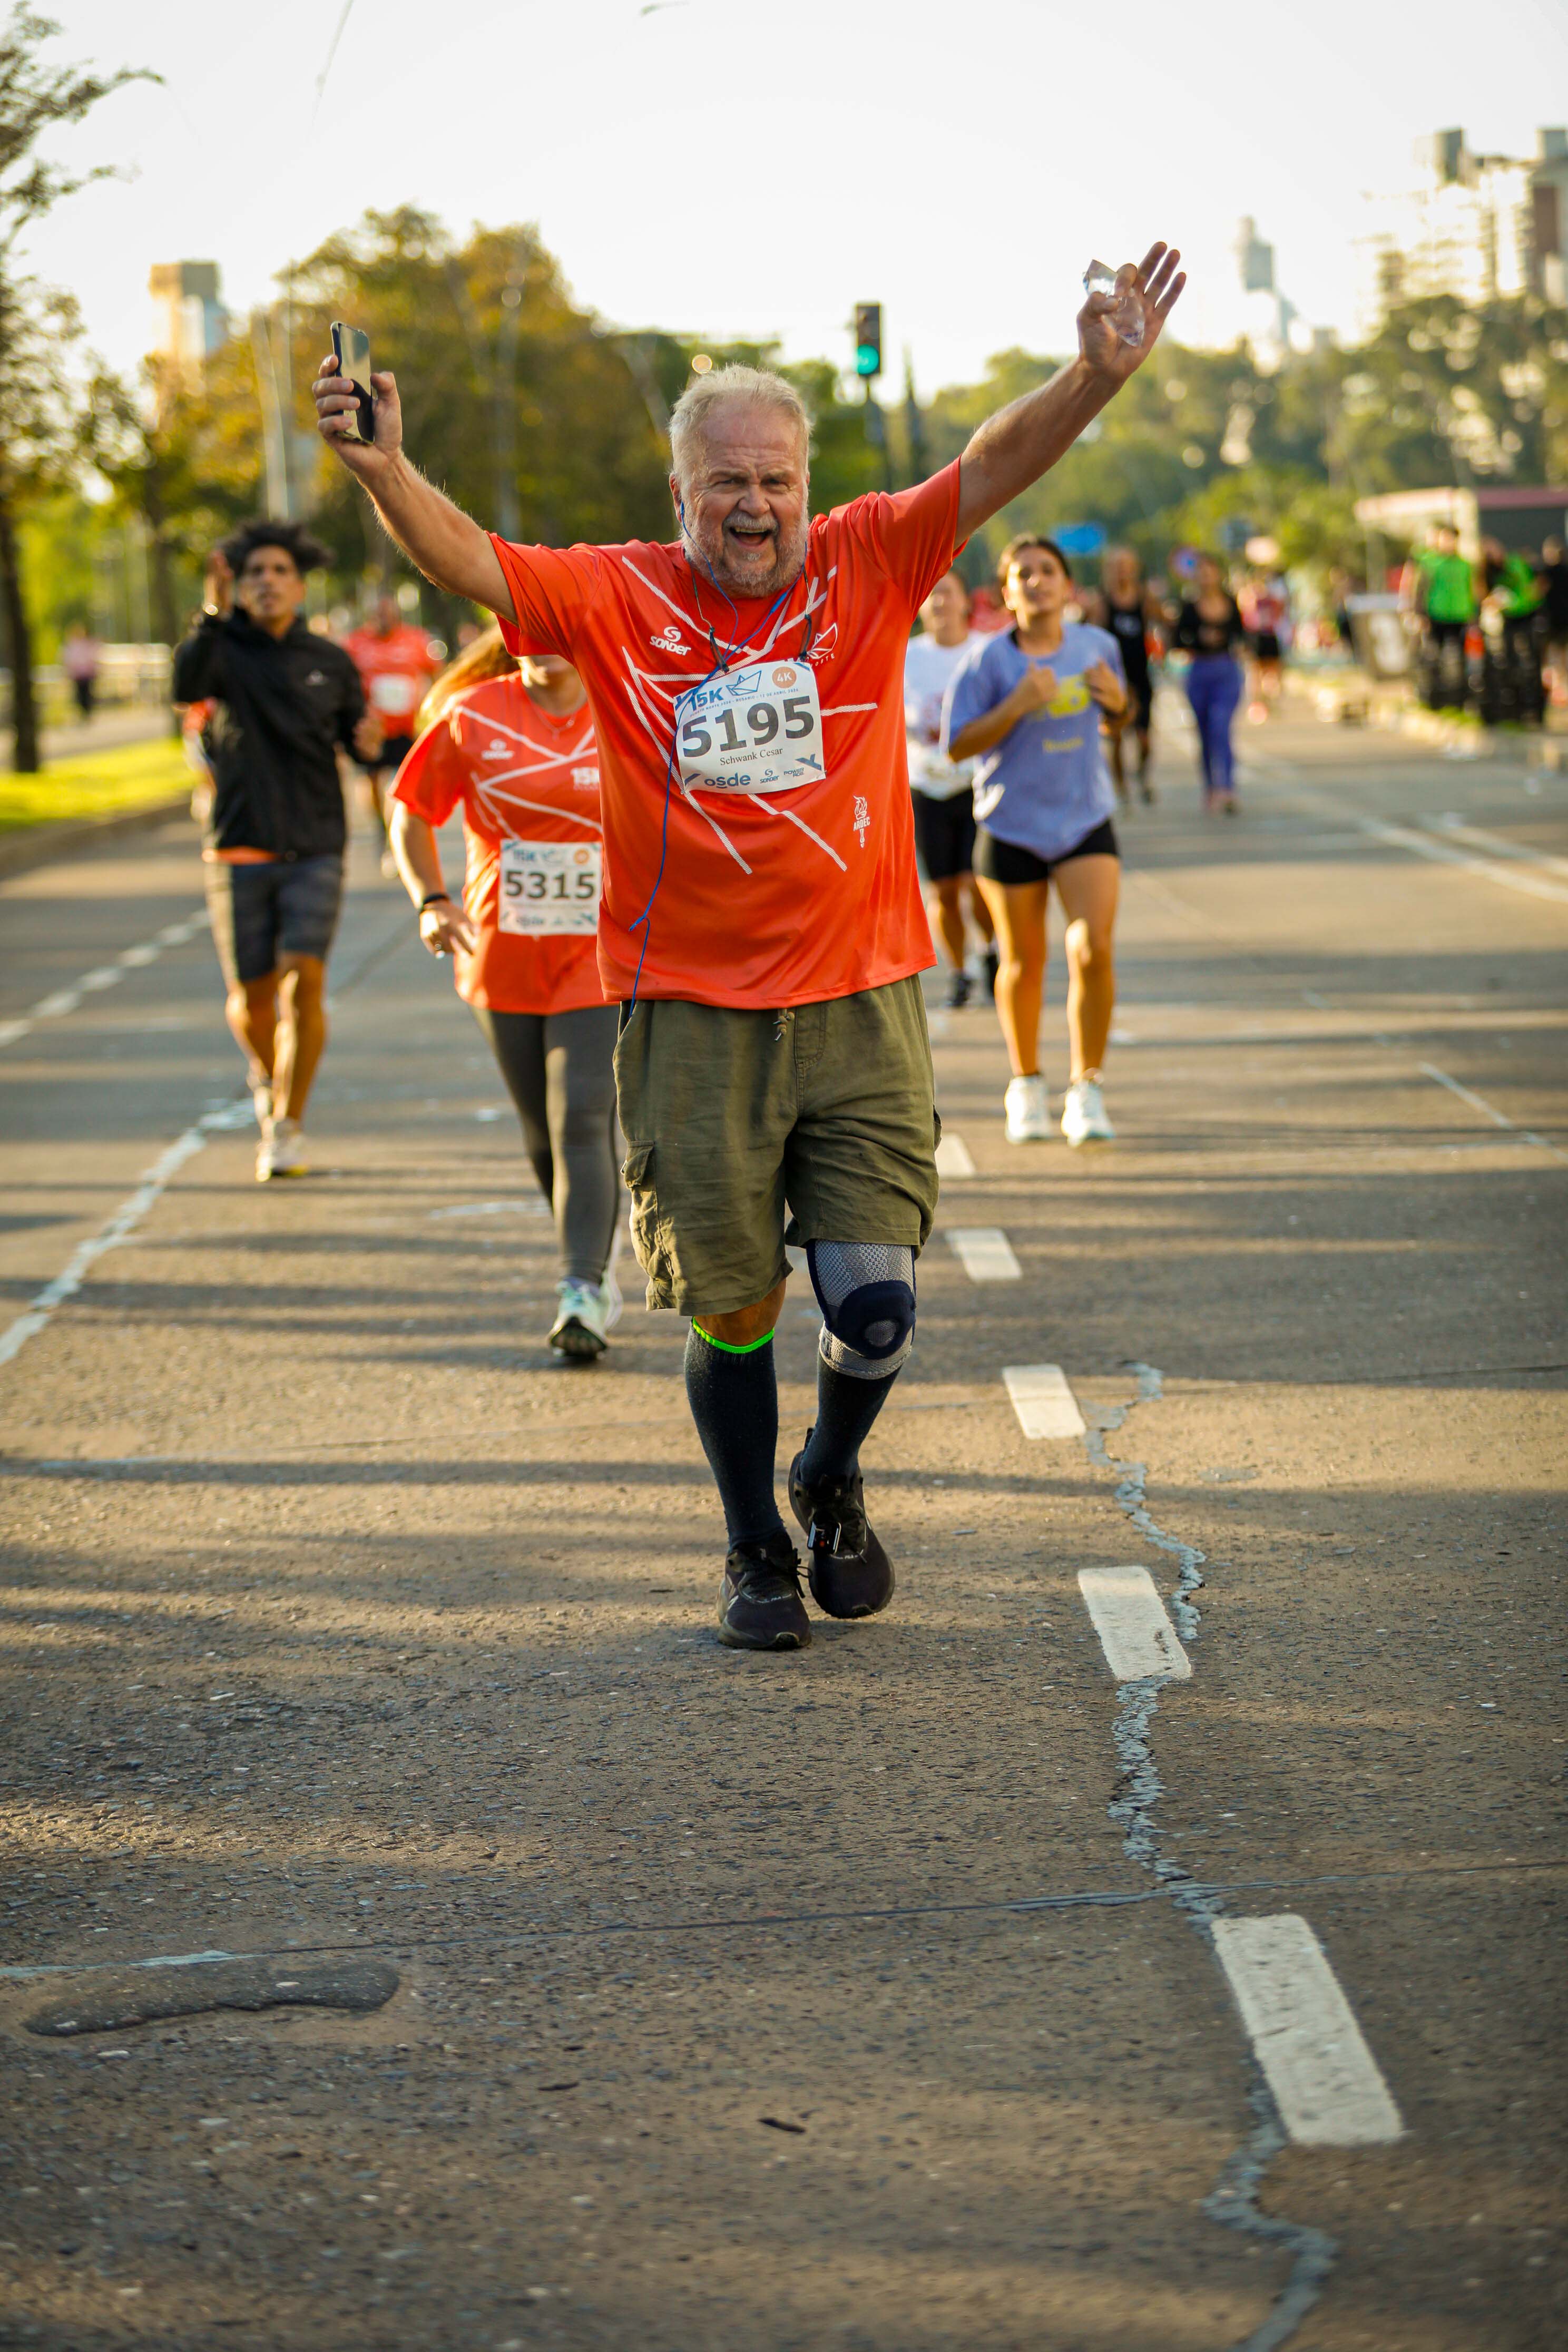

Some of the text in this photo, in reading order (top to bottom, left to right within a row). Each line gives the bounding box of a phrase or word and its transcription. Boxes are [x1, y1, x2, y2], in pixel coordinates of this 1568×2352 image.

[810, 653, 835, 668] ORTE
[777, 672, 793, 682] 4K
[689, 687, 724, 711] 15K
[683, 695, 814, 757] 5195
[720, 748, 783, 766] Schwank Cesar
[704, 772, 751, 789] osde
[852, 816, 870, 831] ARDEC
[505, 870, 595, 900] 5315
